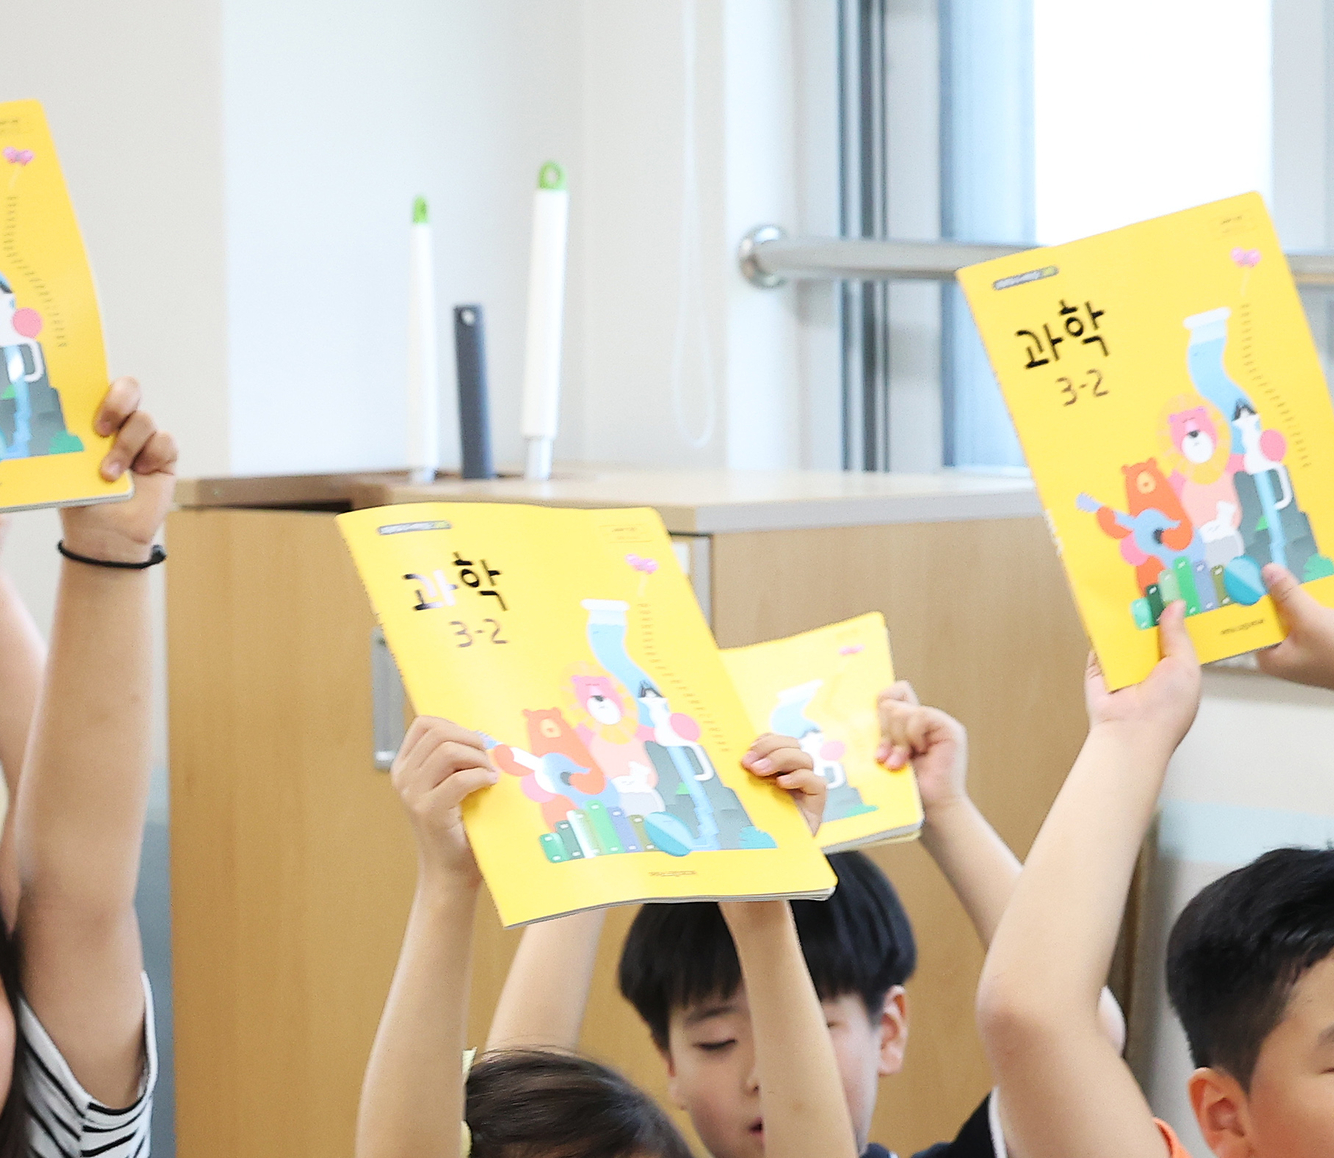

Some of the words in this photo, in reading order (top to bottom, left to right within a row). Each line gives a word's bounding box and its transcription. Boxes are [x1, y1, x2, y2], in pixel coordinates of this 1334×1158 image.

[1015, 299, 1110, 370] 과학
[1055, 368, 1110, 407] 3-2
[401, 550, 509, 612] 과학
[448, 618, 509, 648] 3-2
